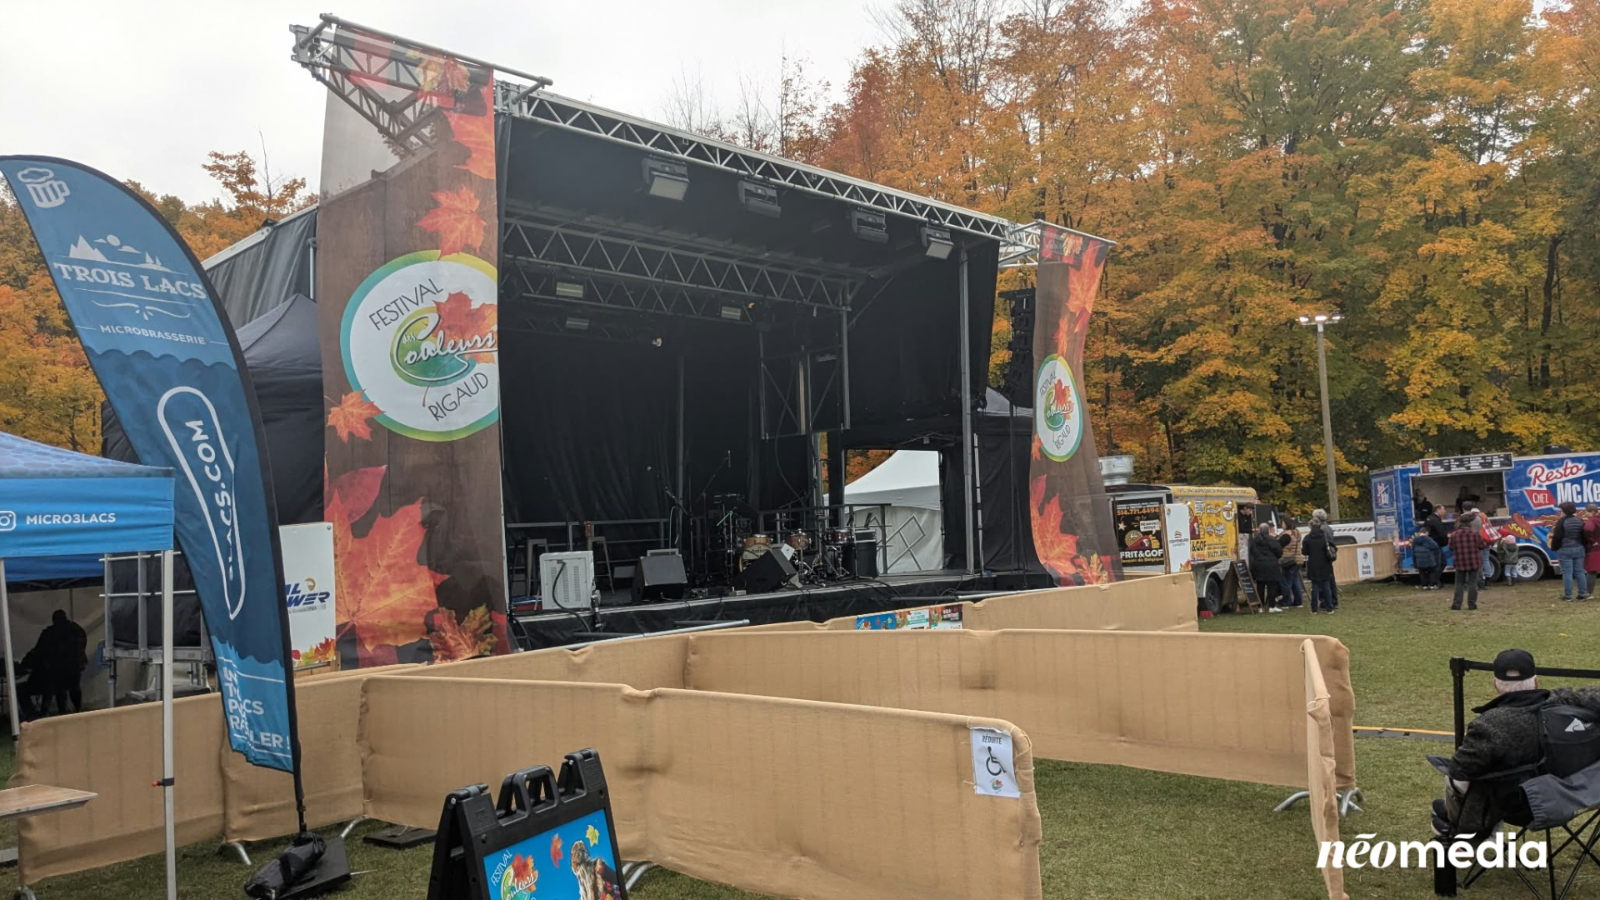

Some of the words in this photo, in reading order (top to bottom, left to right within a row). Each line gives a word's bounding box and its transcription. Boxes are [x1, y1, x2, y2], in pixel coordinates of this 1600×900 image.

[53, 261, 135, 288] TROIS
[143, 275, 207, 300] LACS
[369, 278, 444, 331] FESTIVAL
[99, 325, 207, 345] MICROBRASSERIE
[393, 313, 498, 382] Couleurs
[1040, 370, 1057, 396] FESTIVAL
[428, 372, 489, 421] RIGAUD
[1054, 424, 1071, 450] RIGAUD
[1528, 460, 1584, 486] Resto
[1532, 492, 1549, 504] CHEZ
[26, 512, 117, 525] MICRO3LACS
[1120, 548, 1164, 559] FRIT&GOF
[286, 591, 331, 608] WER
[490, 849, 513, 886] FESTIVAL
